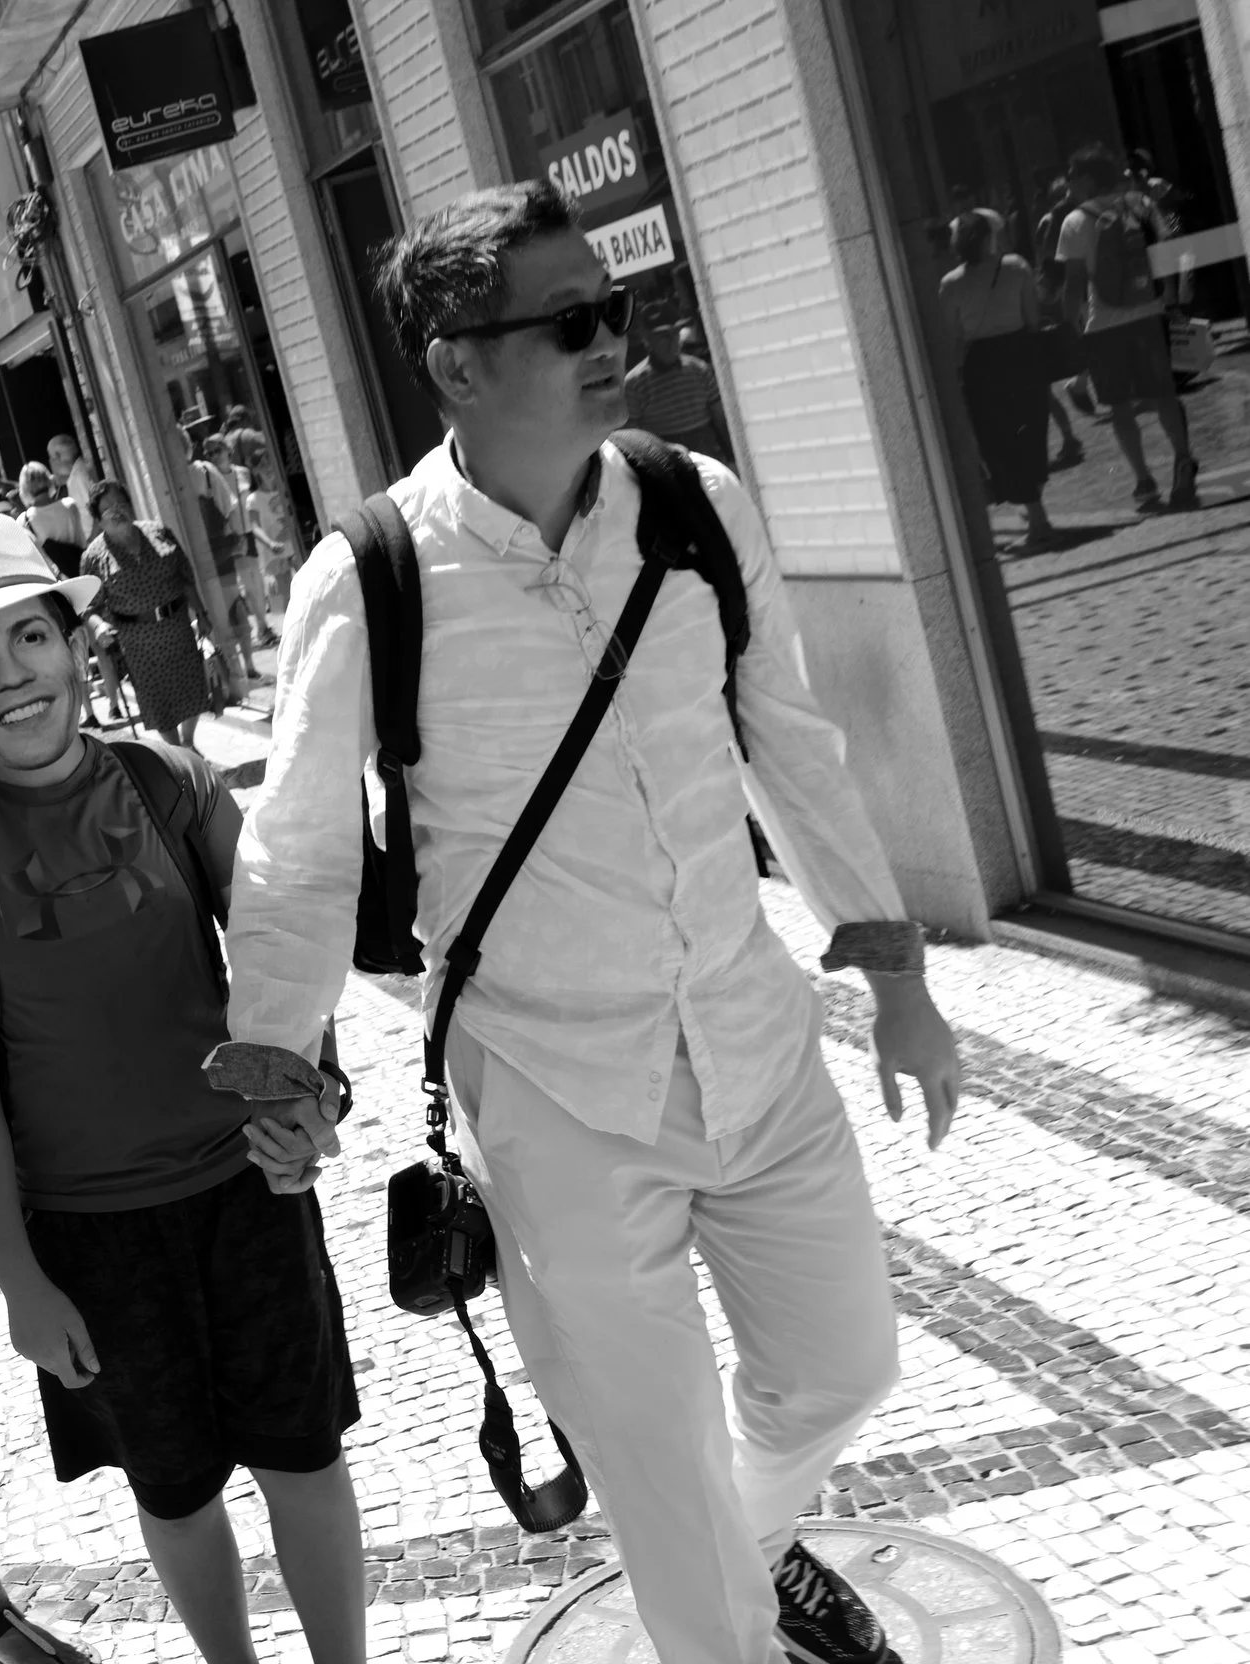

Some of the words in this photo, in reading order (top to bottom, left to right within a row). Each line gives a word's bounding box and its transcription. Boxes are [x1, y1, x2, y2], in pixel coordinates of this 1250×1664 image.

[111, 92, 217, 133] eureka
[548, 129, 637, 199] SALDOS
[120, 186, 168, 243] CASA
[610, 219, 667, 267] BAIXA
